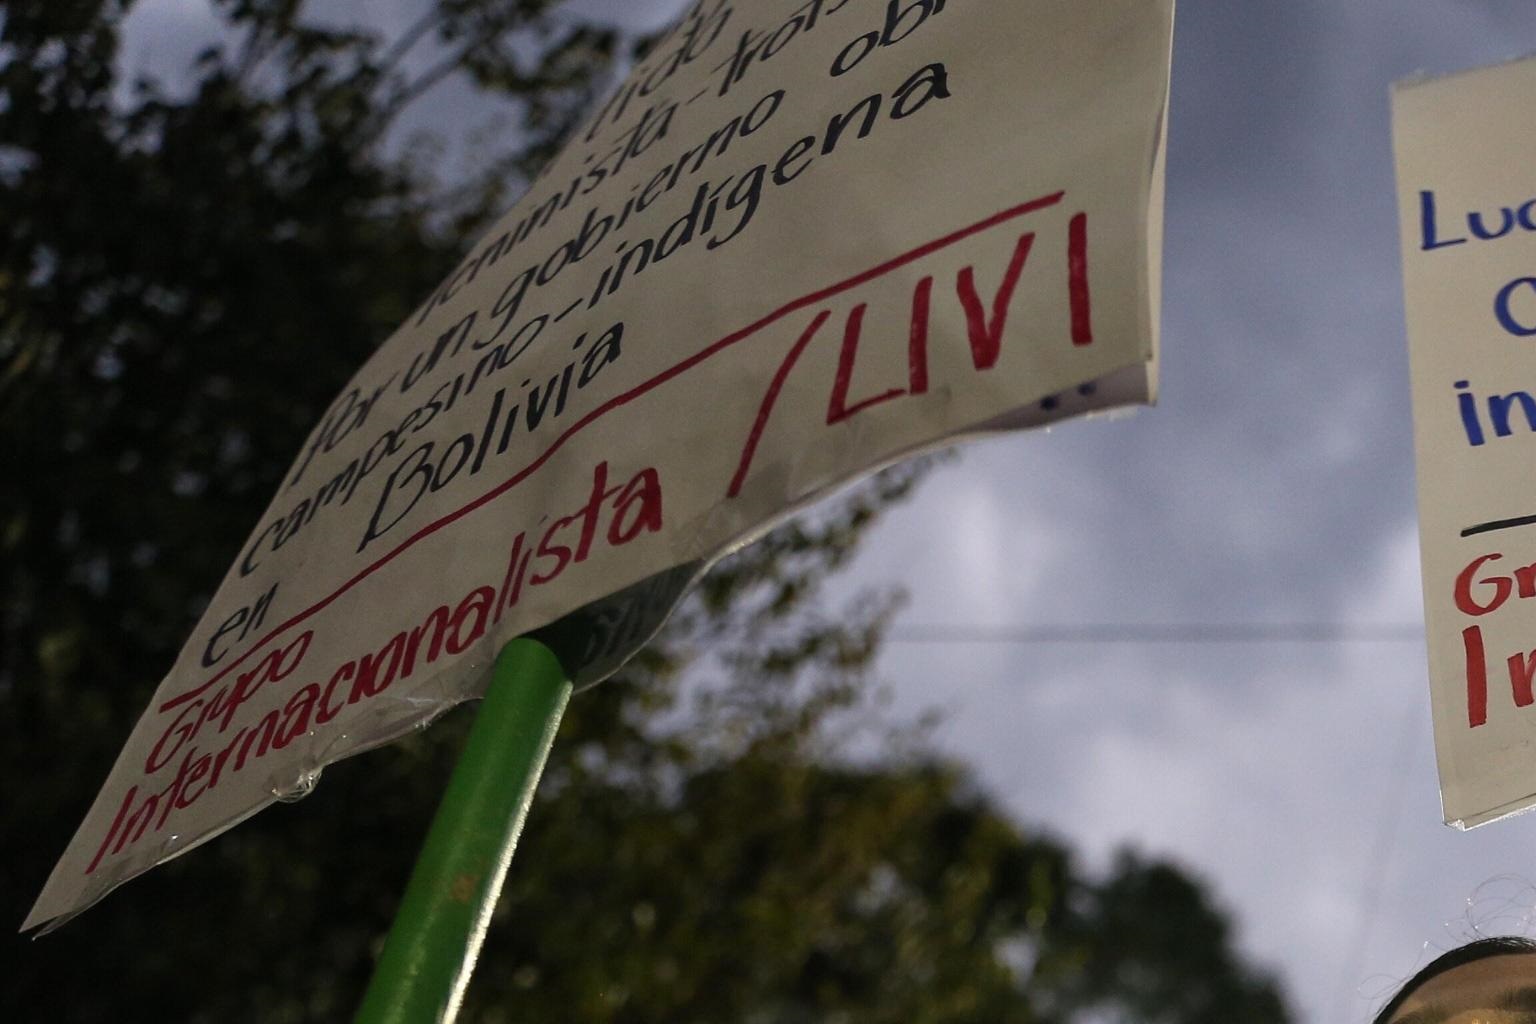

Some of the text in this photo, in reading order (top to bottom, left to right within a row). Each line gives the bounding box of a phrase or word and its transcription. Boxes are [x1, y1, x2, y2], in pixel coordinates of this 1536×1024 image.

[402, 310, 479, 393] un
[472, 90, 786, 351] gobierno
[202, 322, 624, 667] en Bolivia
[86, 461, 662, 874] Internacionalista
[144, 630, 314, 774] Grupo
